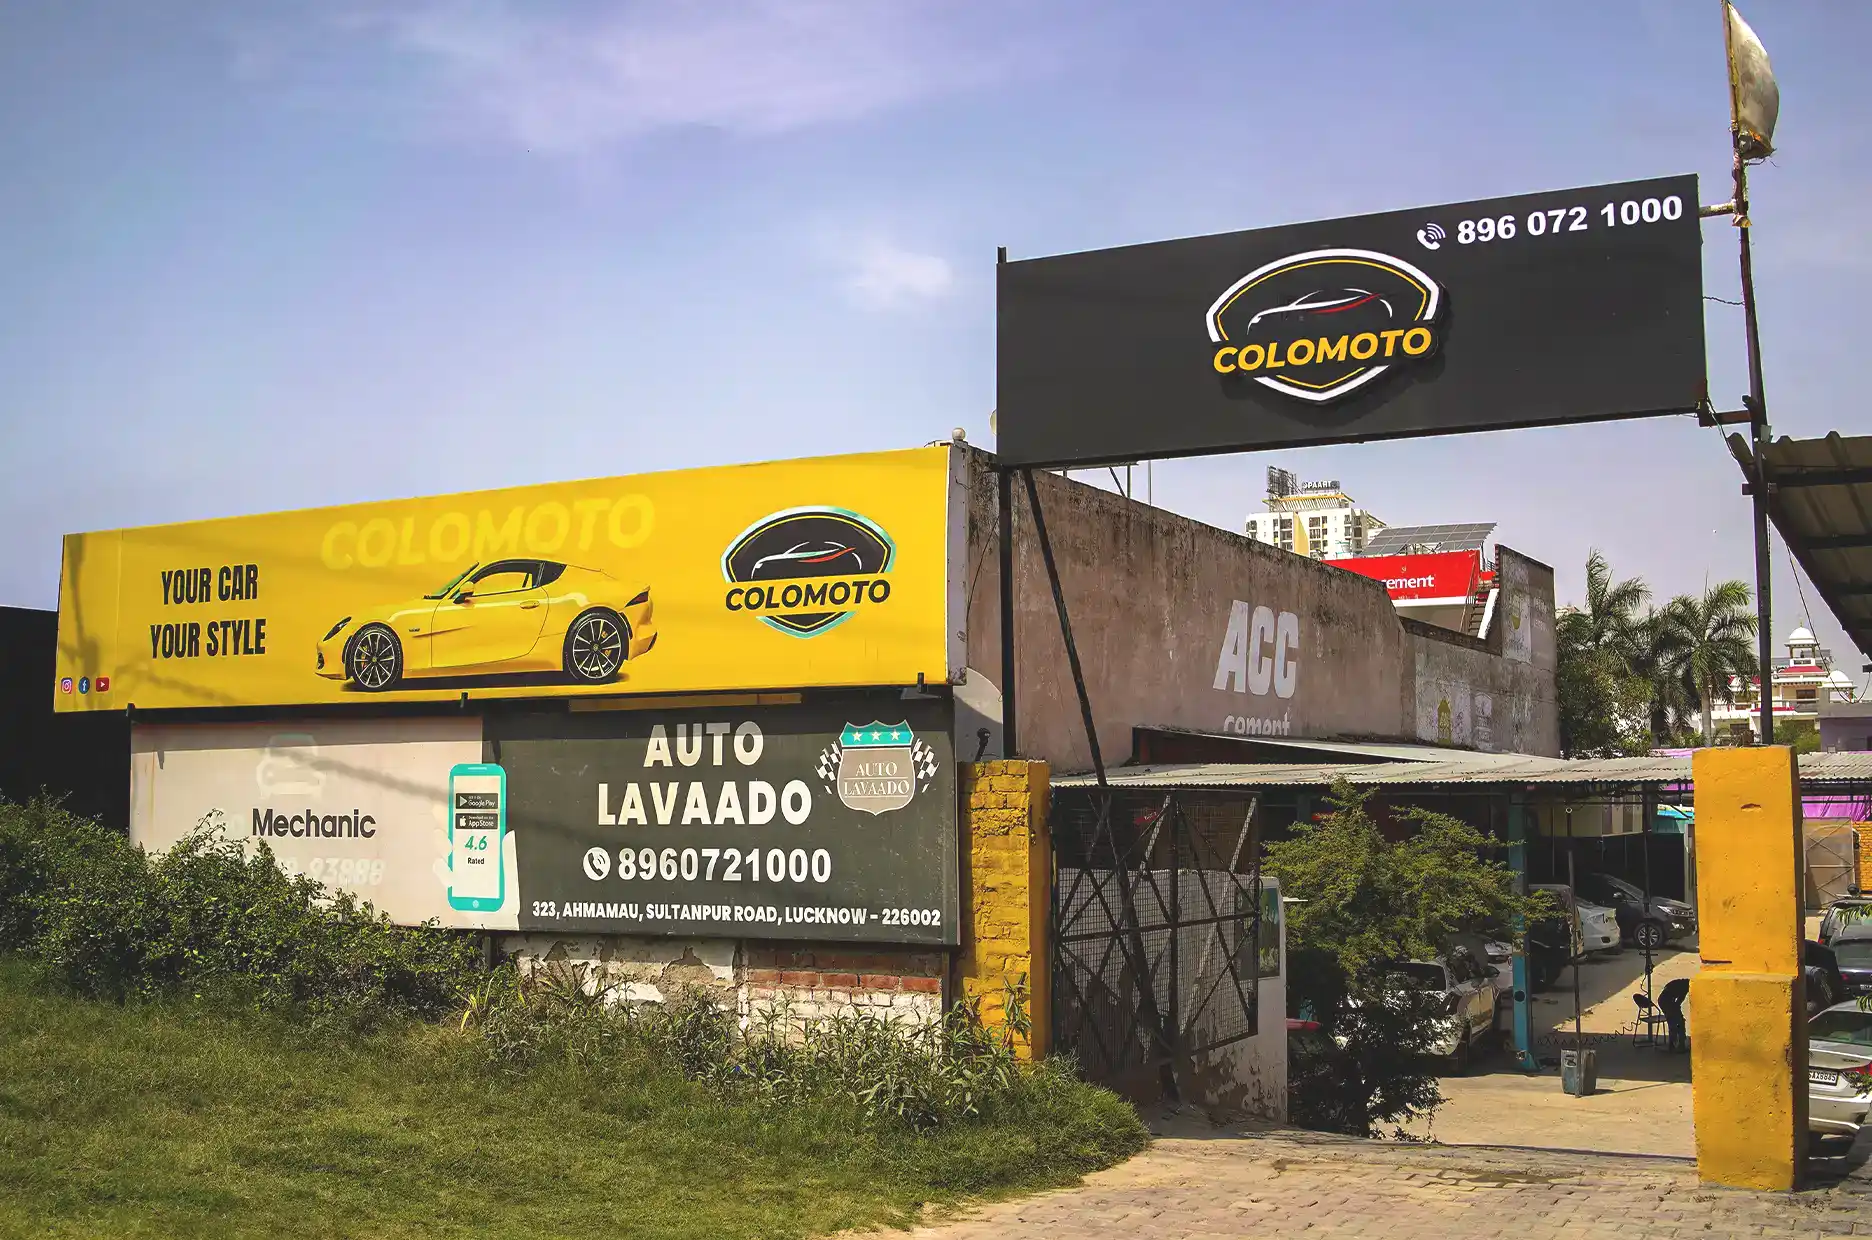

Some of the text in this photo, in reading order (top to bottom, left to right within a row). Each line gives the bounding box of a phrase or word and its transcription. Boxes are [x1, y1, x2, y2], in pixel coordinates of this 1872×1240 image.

[1457, 195, 1684, 246] 896 072 1000
[1212, 326, 1433, 375] COLOMOTO
[321, 494, 656, 570] COLOMOTO
[161, 564, 259, 606] YOUR CAR
[725, 579, 891, 611] COLOMOTO
[1381, 575, 1435, 590] ement
[149, 618, 267, 659] YOUR STYLE
[1212, 599, 1299, 699] ACC
[643, 720, 765, 768] AUTO
[855, 761, 898, 777] AUTO
[597, 779, 813, 826] LAVAADO
[843, 779, 910, 796] LAVAADO
[252, 808, 377, 838] Mechanic
[468, 819, 494, 828] App Store
[464, 835, 488, 851] 4.6
[467, 857, 485, 865] Rated
[618, 847, 832, 883] 8960721000
[532, 901, 560, 919] 323,
[562, 902, 643, 922] AHMAMAU,
[646, 903, 731, 921] SULTANPUR
[734, 905, 782, 926] ROAD,
[785, 907, 867, 925] LUCKNOW
[882, 908, 941, 926] 226002
